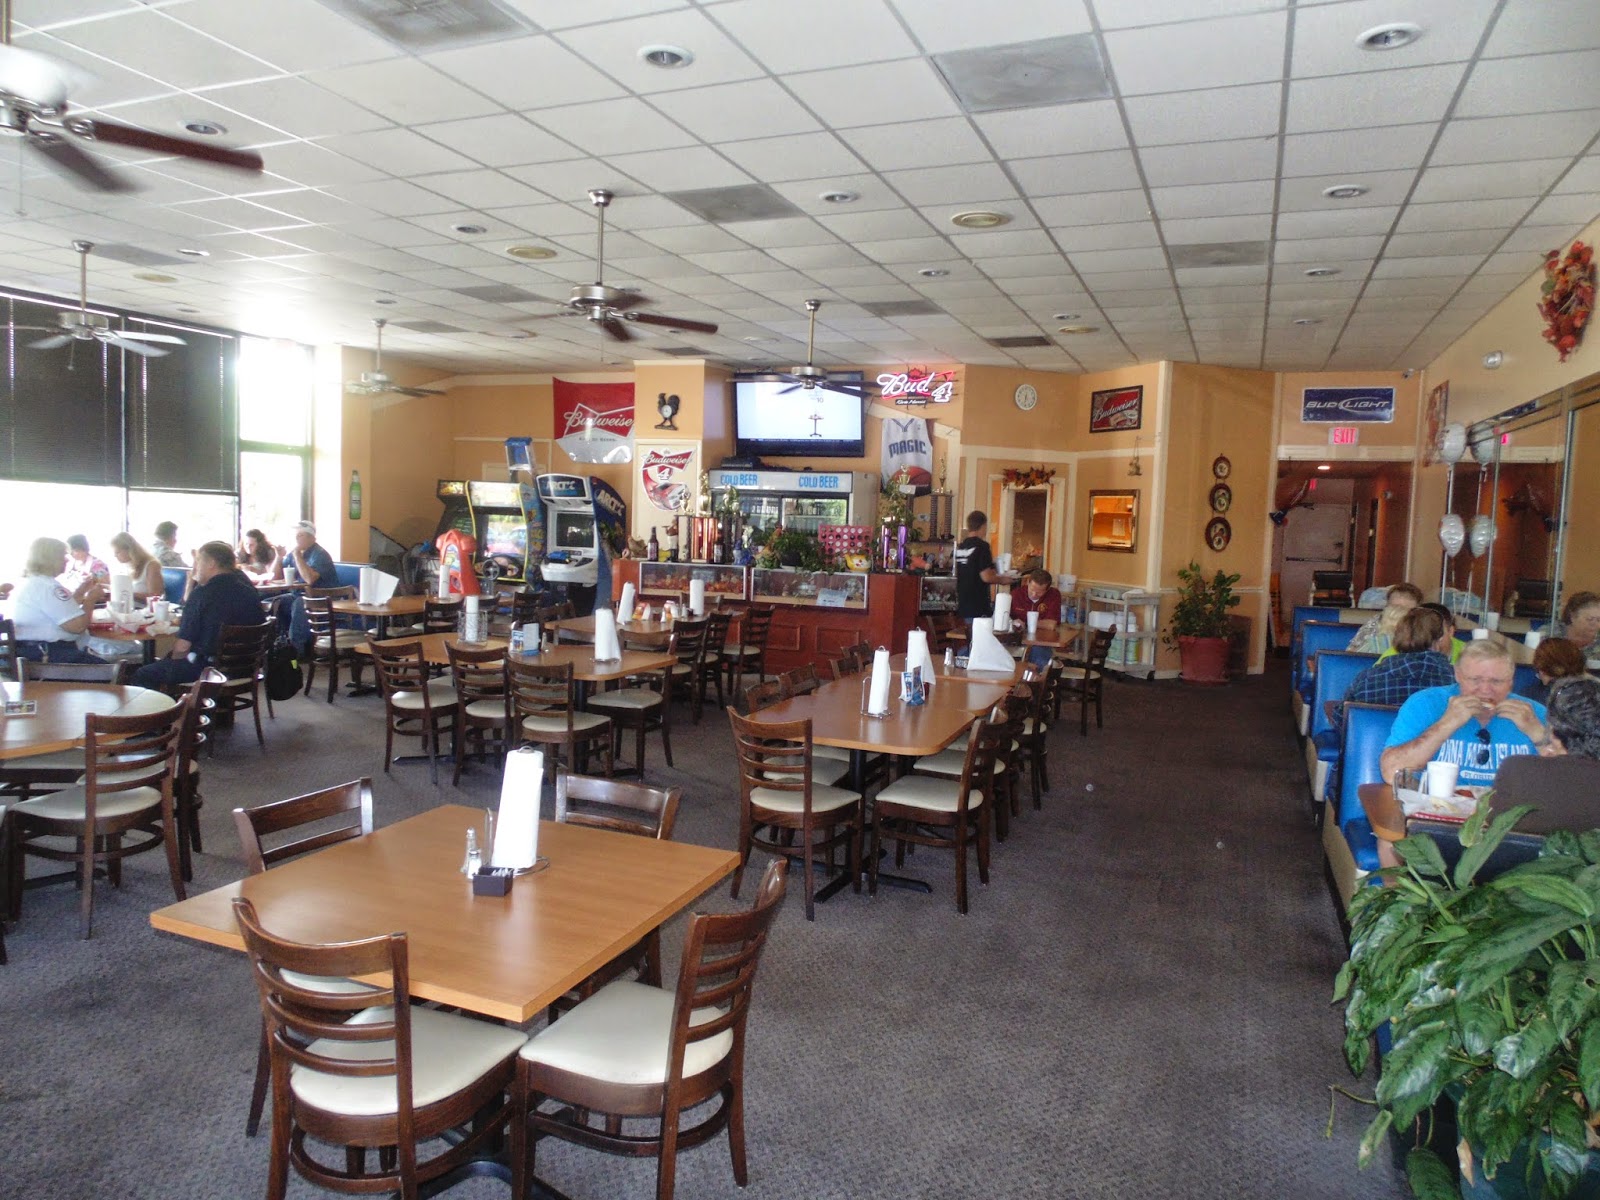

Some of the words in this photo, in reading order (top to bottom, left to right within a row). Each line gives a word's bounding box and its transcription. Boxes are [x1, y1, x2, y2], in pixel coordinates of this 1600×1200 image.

[876, 372, 935, 395] Bud
[931, 381, 953, 403] 4
[1093, 398, 1138, 421] Budweiser
[1306, 401, 1338, 409] BUD
[1345, 401, 1390, 409] LIGHT
[564, 411, 635, 427] Budweise
[1334, 428, 1356, 444] EXIT
[888, 439, 927, 458] MAGIC
[720, 474, 738, 486] COLD
[739, 474, 758, 486] BEER
[798, 476, 818, 488] COLD
[819, 476, 839, 488] BEER
